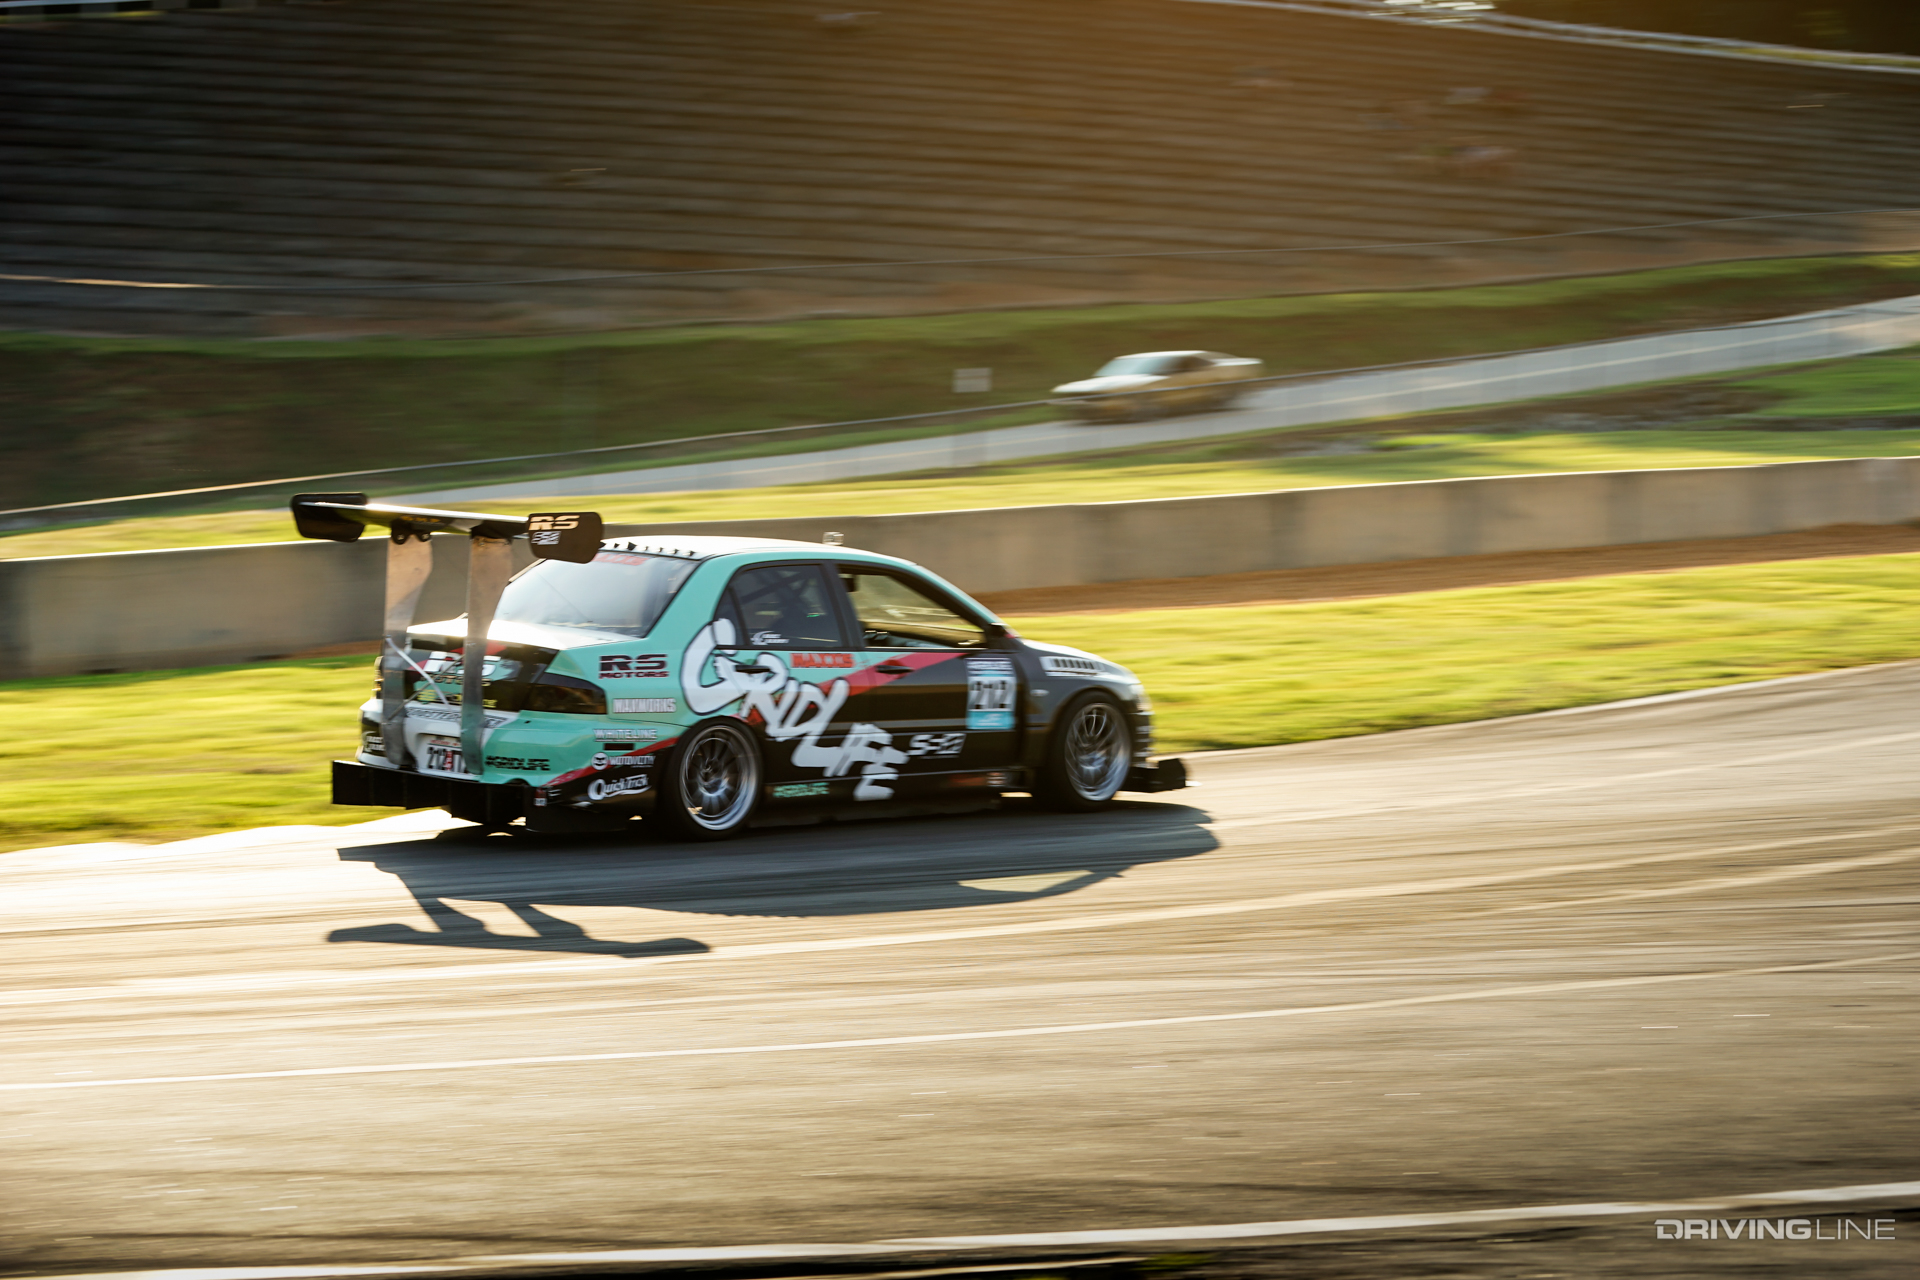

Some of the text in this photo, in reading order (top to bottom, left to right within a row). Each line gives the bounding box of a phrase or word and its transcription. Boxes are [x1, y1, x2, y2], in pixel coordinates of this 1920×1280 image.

[528, 515, 580, 531] RS
[598, 653, 669, 671] RS
[598, 671, 670, 679] MOTORS
[593, 728, 658, 740] WHITELINE
